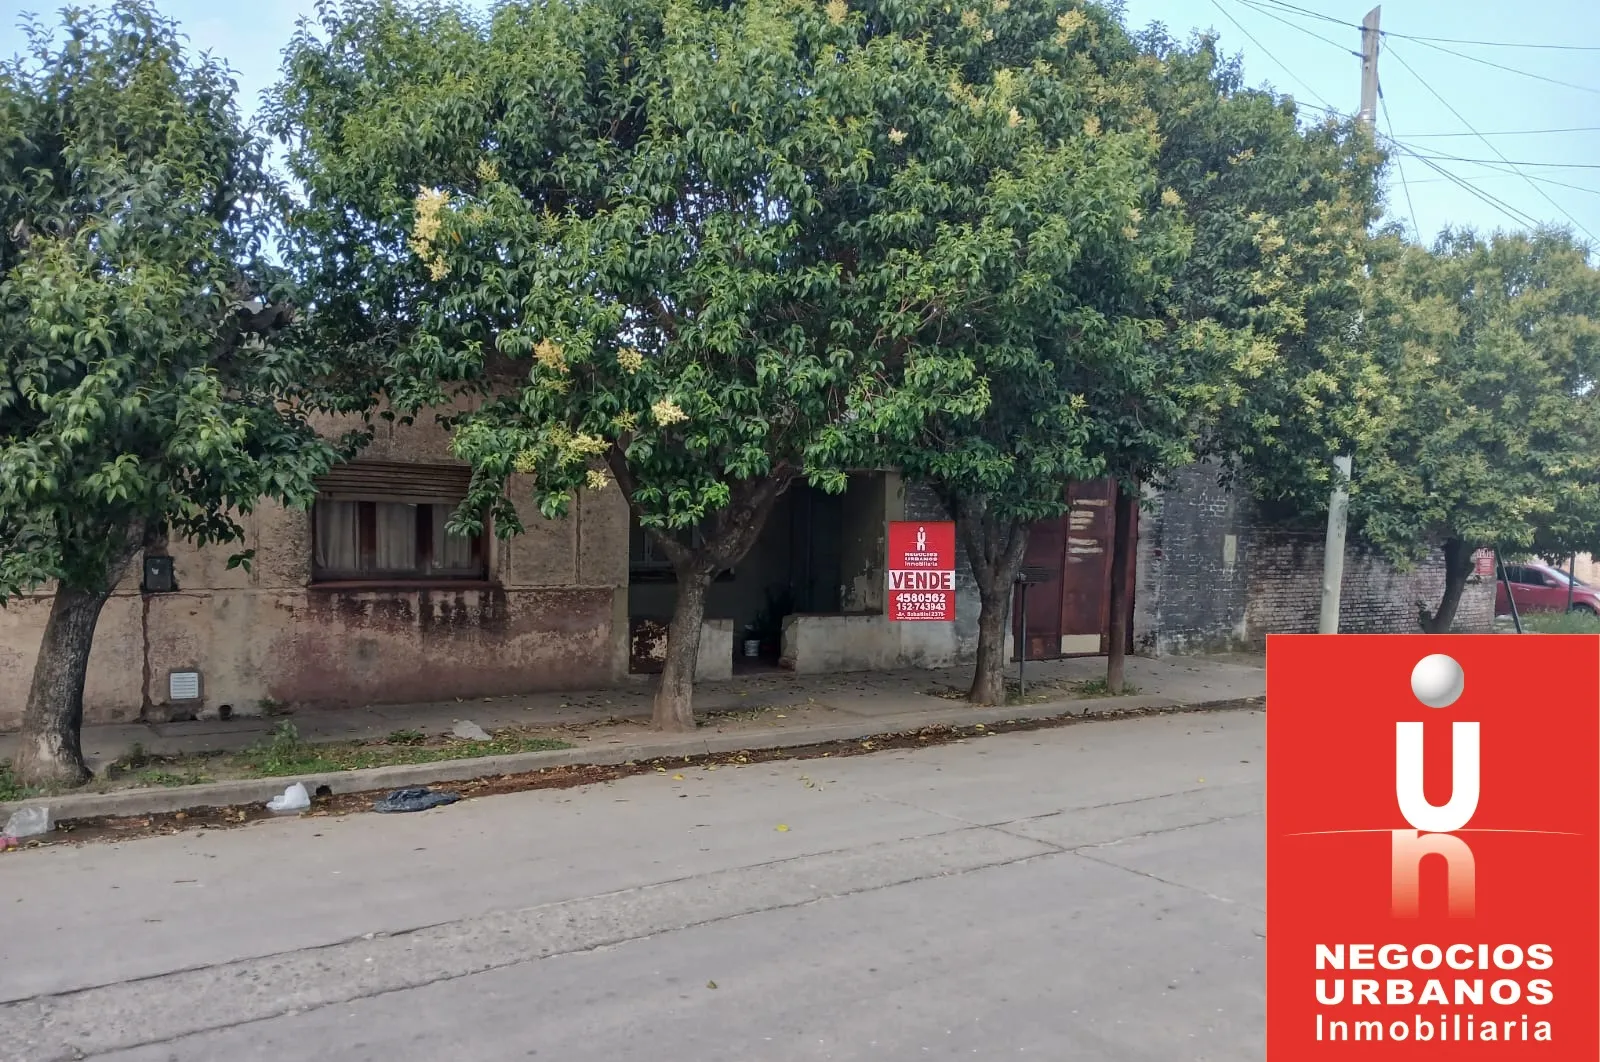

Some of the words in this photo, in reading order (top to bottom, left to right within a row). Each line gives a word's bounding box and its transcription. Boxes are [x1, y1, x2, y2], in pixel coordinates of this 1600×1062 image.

[892, 572, 950, 590] VENDE
[895, 593, 946, 603] 4580562
[895, 602, 946, 611] 152-743943
